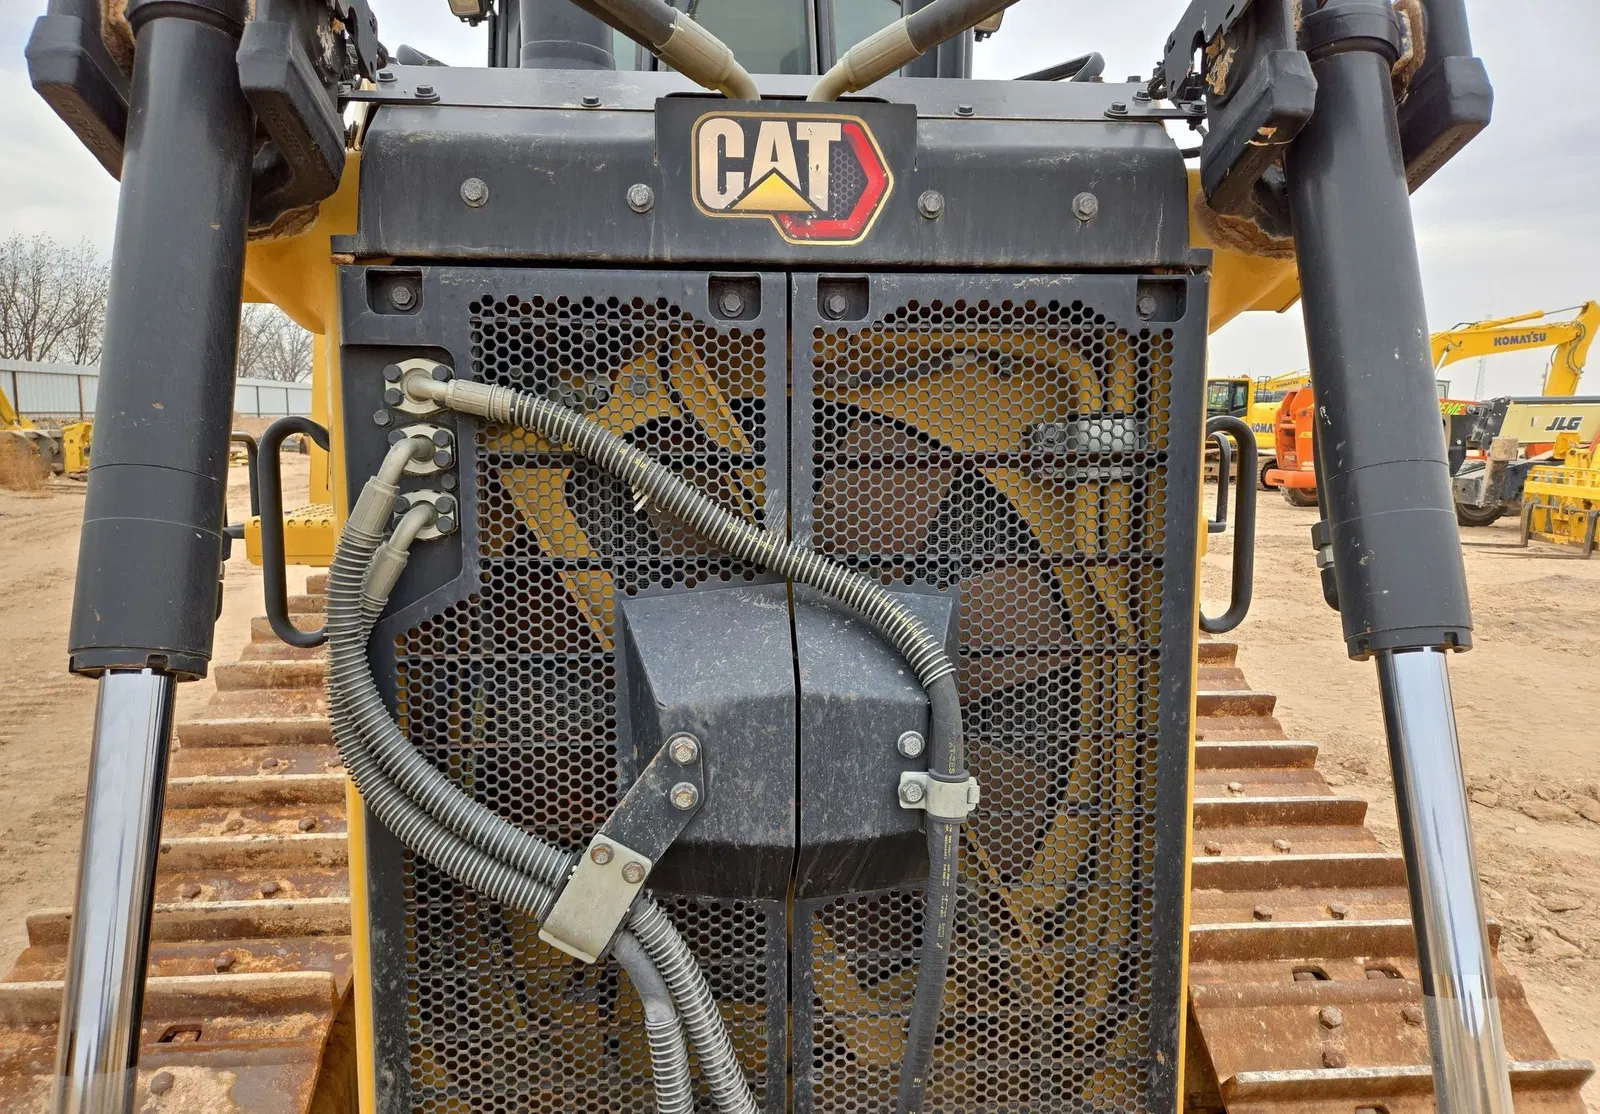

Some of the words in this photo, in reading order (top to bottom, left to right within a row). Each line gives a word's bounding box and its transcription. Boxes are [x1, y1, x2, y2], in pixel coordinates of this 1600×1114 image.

[698, 118, 842, 212] CAT
[1493, 331, 1547, 347] KOMATSU
[1440, 402, 1466, 416] EME
[1251, 422, 1275, 434] KOMA
[1545, 416, 1584, 431] JLG
